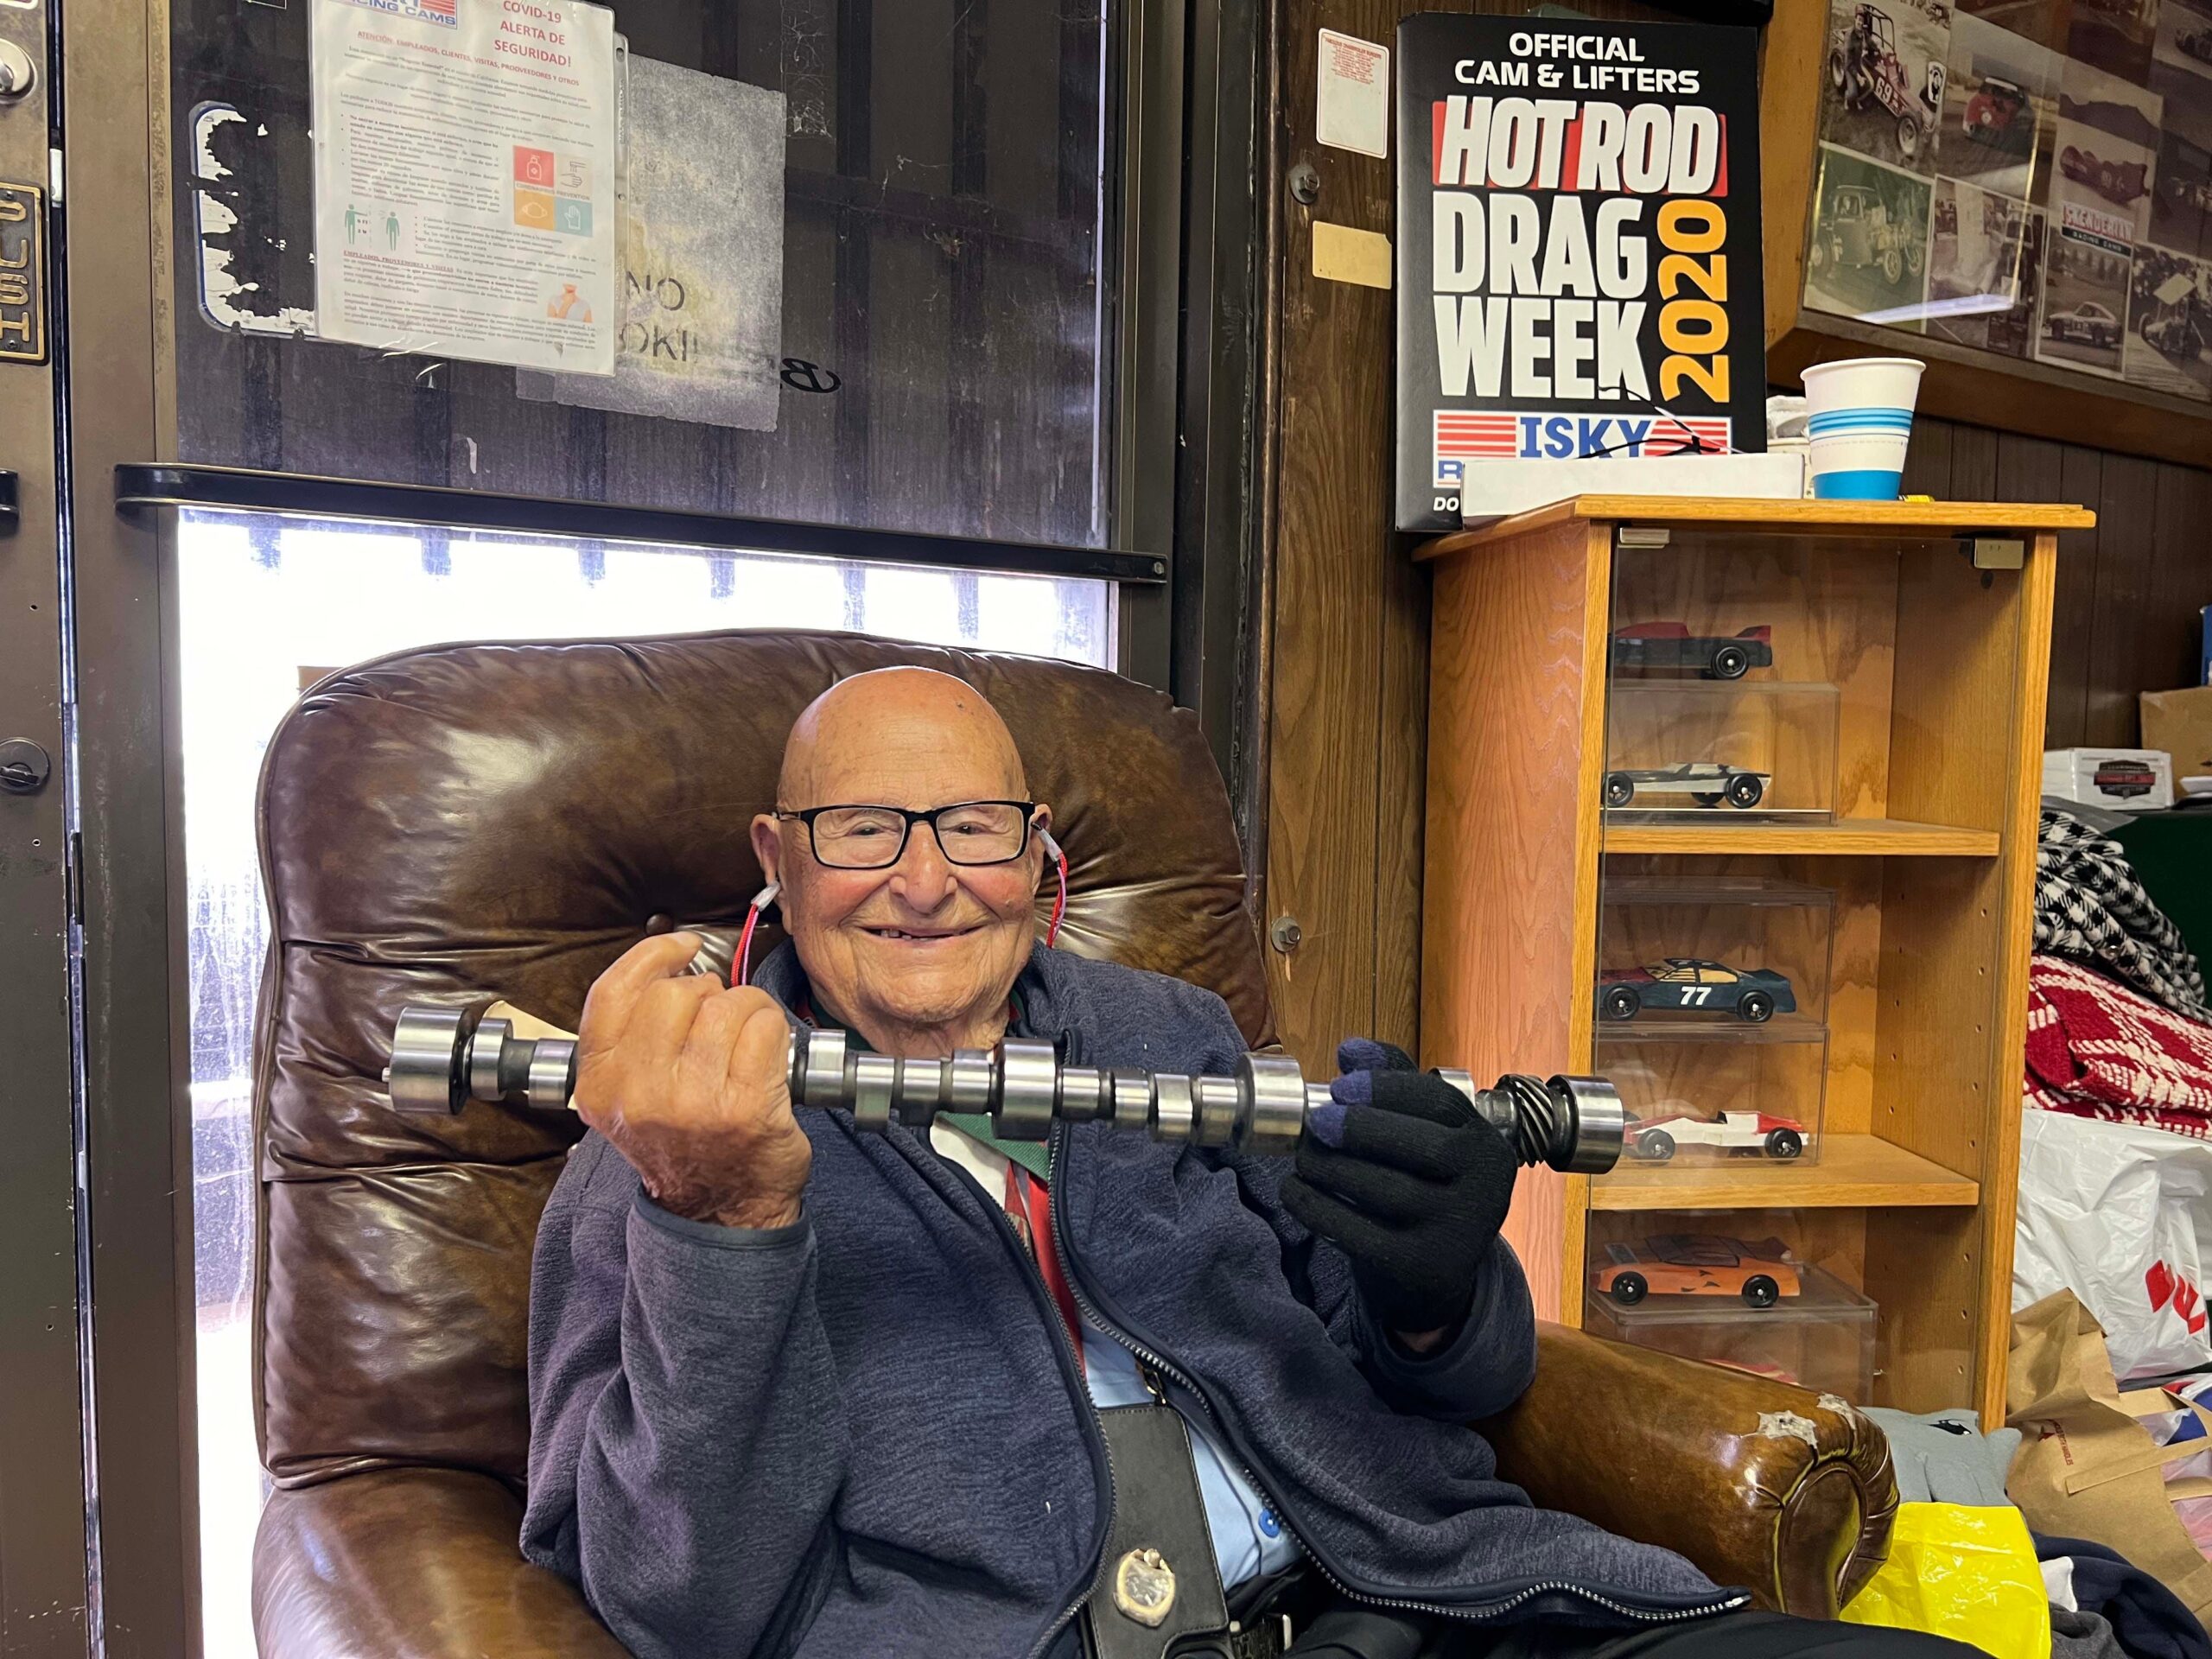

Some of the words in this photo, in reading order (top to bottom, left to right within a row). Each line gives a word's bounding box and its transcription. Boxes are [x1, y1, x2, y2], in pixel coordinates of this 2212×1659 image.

[405, 6, 456, 25] CAMS
[503, 0, 562, 23] COVID-19
[500, 20, 545, 41] ALERTA
[549, 32, 565, 45] DE
[1509, 32, 1645, 62] OFFICIAL
[494, 40, 571, 67] SEGURIDAD!
[1454, 59, 1529, 86] CAM
[1537, 64, 1564, 88] &
[1573, 65, 1700, 94] LIFTERS
[1873, 76, 1893, 105] 69
[1438, 95, 1578, 189] HOT
[1576, 101, 1719, 194] ROD
[1433, 190, 1648, 299] DRAG
[626, 270, 685, 312] NO
[1656, 199, 1730, 404] 2020
[1433, 295, 1652, 402] WEEK
[1520, 416, 1652, 459] ISKY
[1433, 497, 1459, 512] DO
[1680, 986, 1712, 1006] 77
